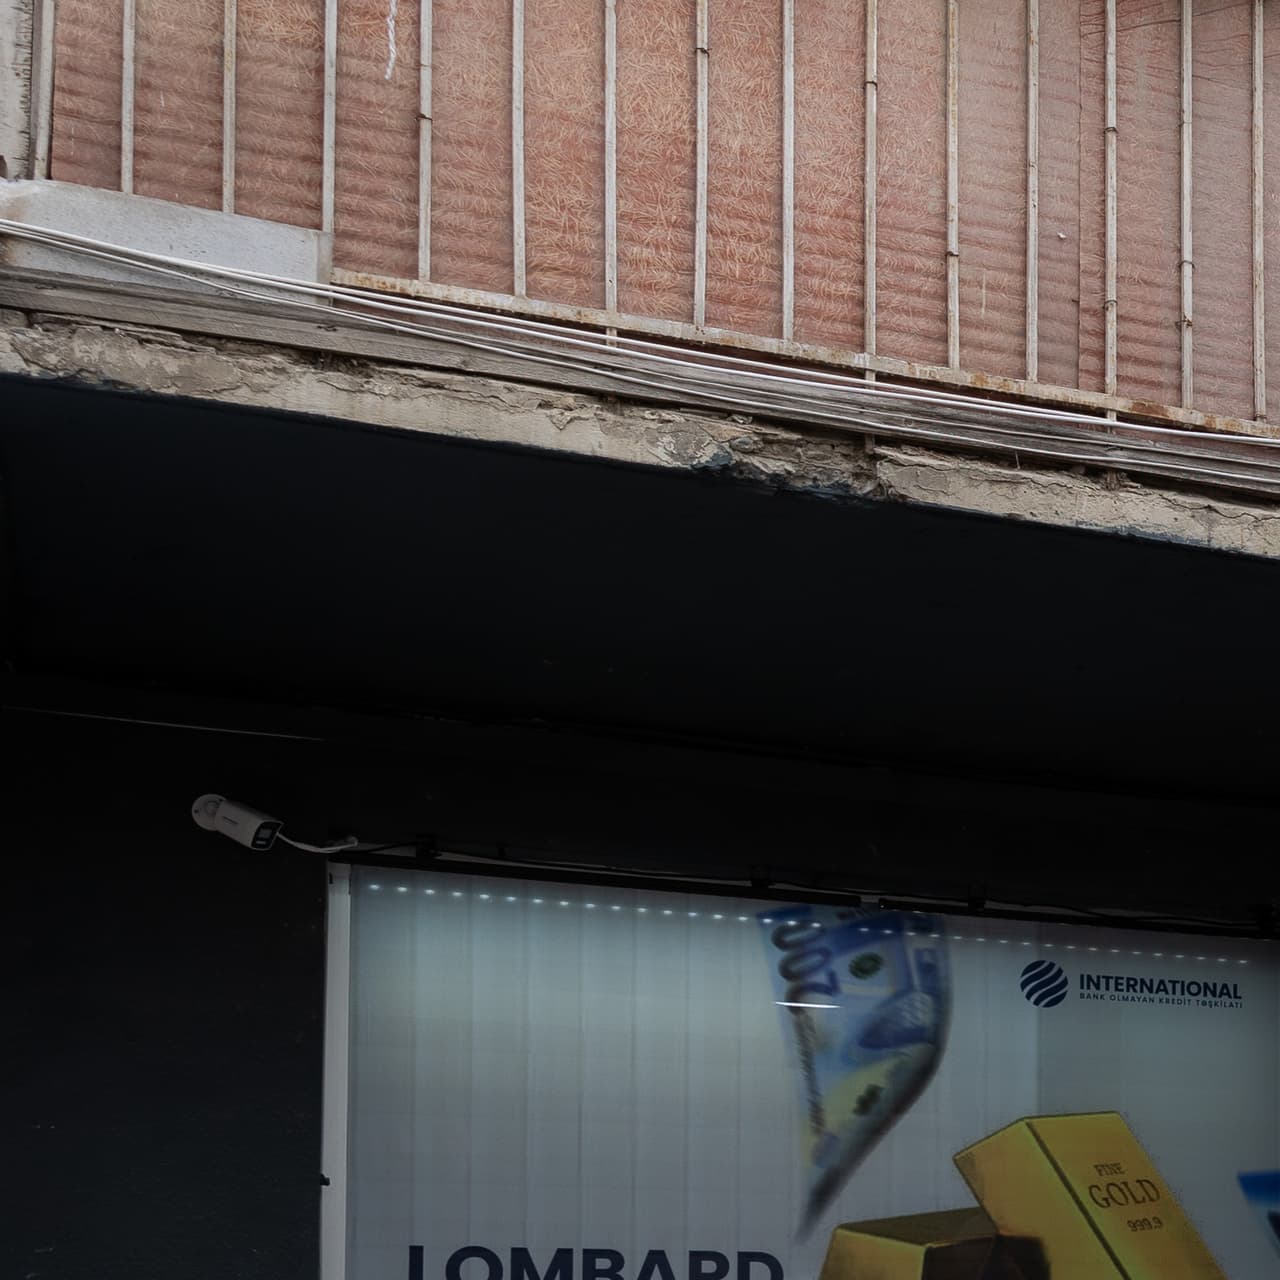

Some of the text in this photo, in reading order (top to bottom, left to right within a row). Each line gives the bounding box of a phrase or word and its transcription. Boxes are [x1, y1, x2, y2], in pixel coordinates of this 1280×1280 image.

[1080, 974, 1242, 1000] INTERNATIONAL
[1080, 992, 1105, 1000] BANK
[1109, 993, 1154, 1003] OLMAYAN
[1094, 1163, 1126, 1177] FINE
[1089, 1179, 1161, 1209] GOLD
[1127, 1215, 1163, 1232] 999.9
